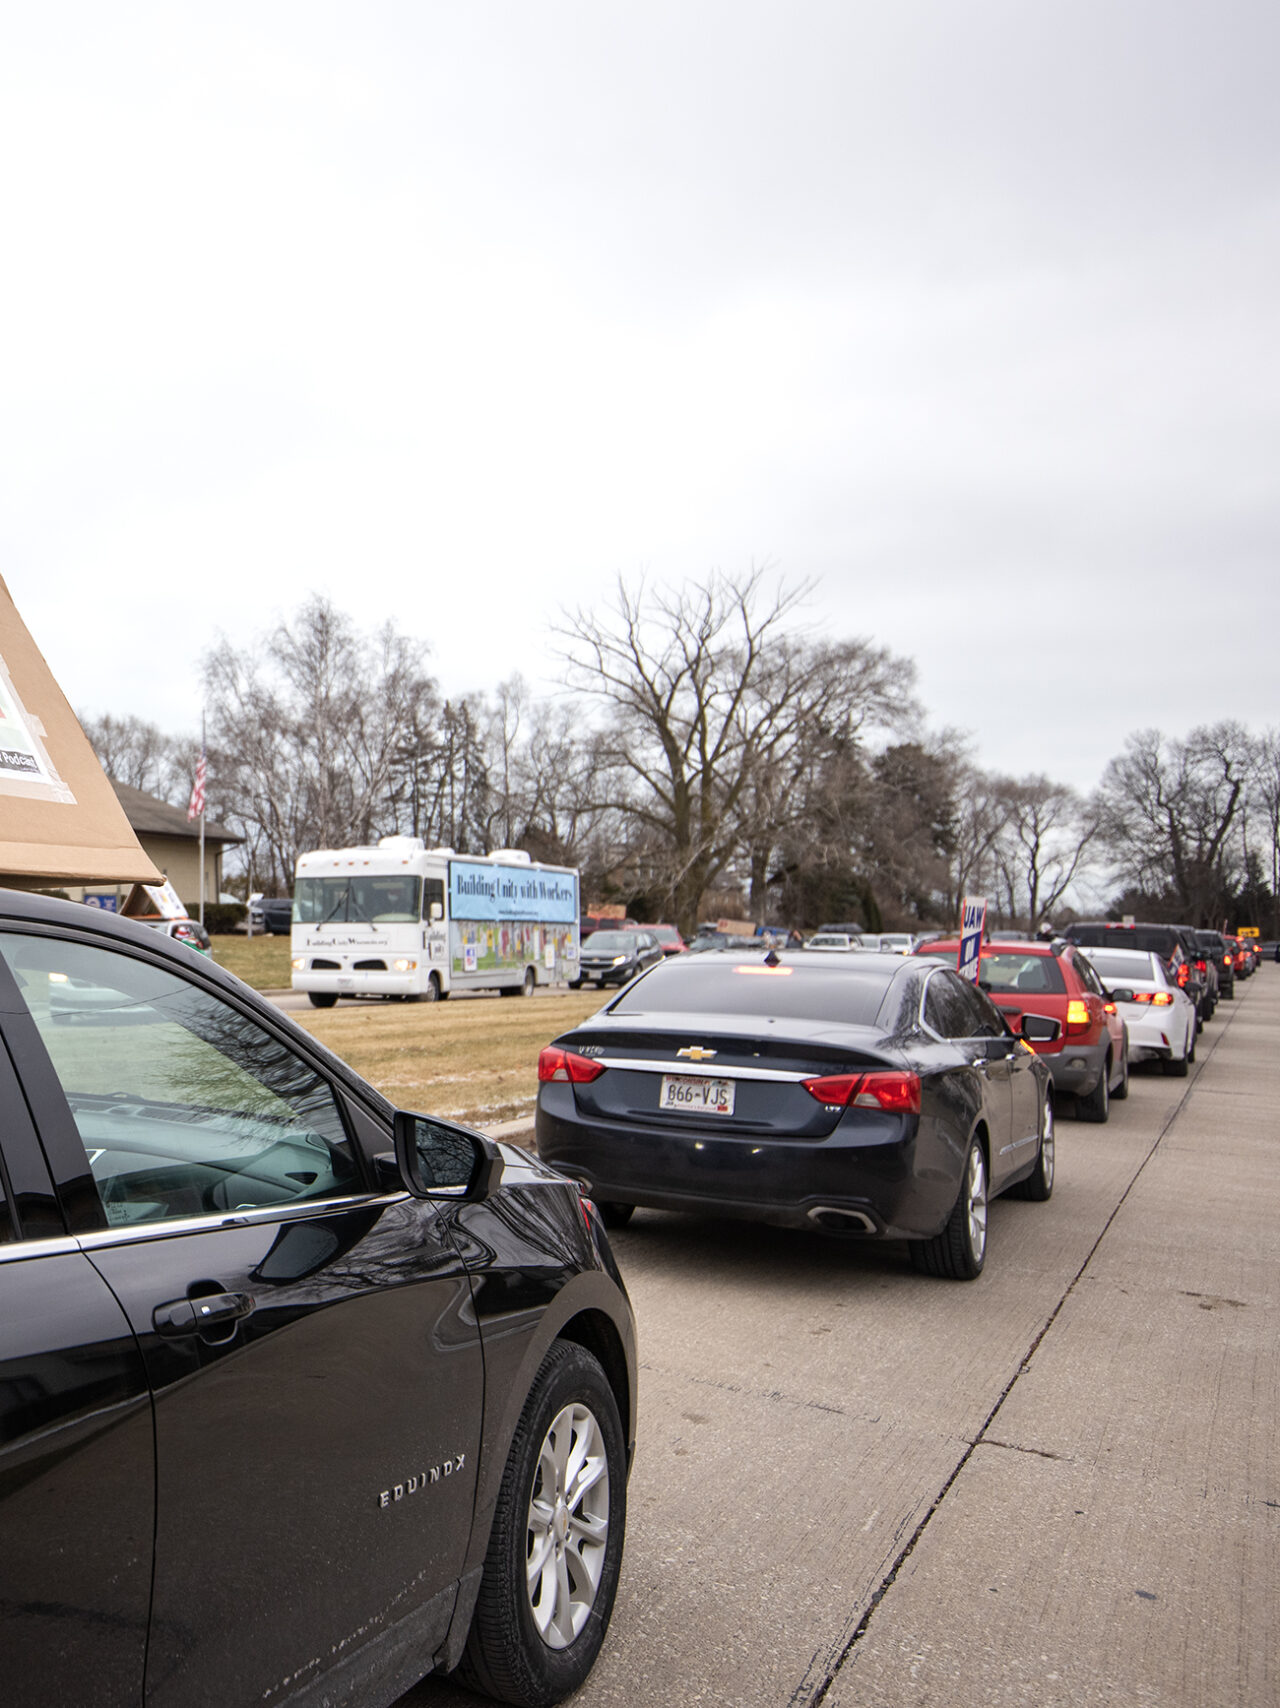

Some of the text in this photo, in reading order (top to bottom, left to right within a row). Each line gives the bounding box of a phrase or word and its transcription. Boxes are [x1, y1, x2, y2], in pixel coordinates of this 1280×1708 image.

[3, 751, 38, 770] Podcast
[457, 873, 573, 904] Building Unity with Workers
[964, 905, 985, 929] UAW
[379, 1453, 465, 1508] EQUINOX
